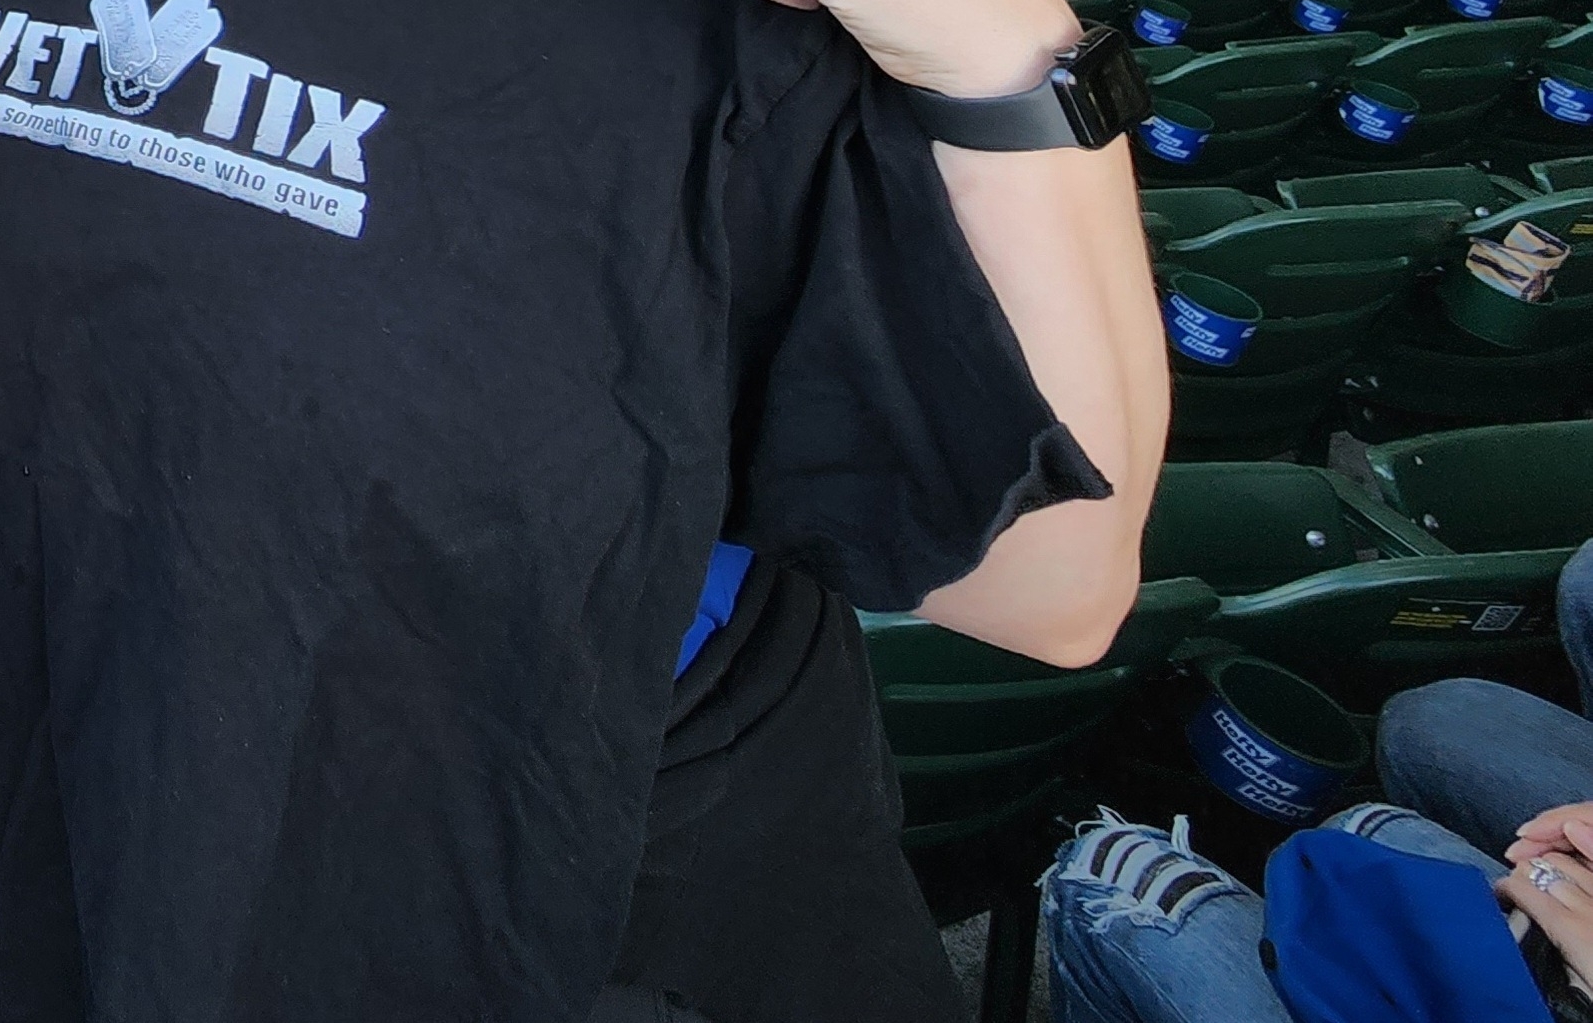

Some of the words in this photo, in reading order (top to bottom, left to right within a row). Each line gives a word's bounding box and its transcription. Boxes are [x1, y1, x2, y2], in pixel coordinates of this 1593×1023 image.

[203, 46, 387, 184] TIX
[2, 106, 104, 147] something
[109, 128, 132, 150] to
[138, 136, 206, 174] those
[214, 159, 266, 192] who
[274, 182, 340, 217] gave
[1215, 711, 1273, 763] Hefty
[1226, 749, 1295, 795] Hefty
